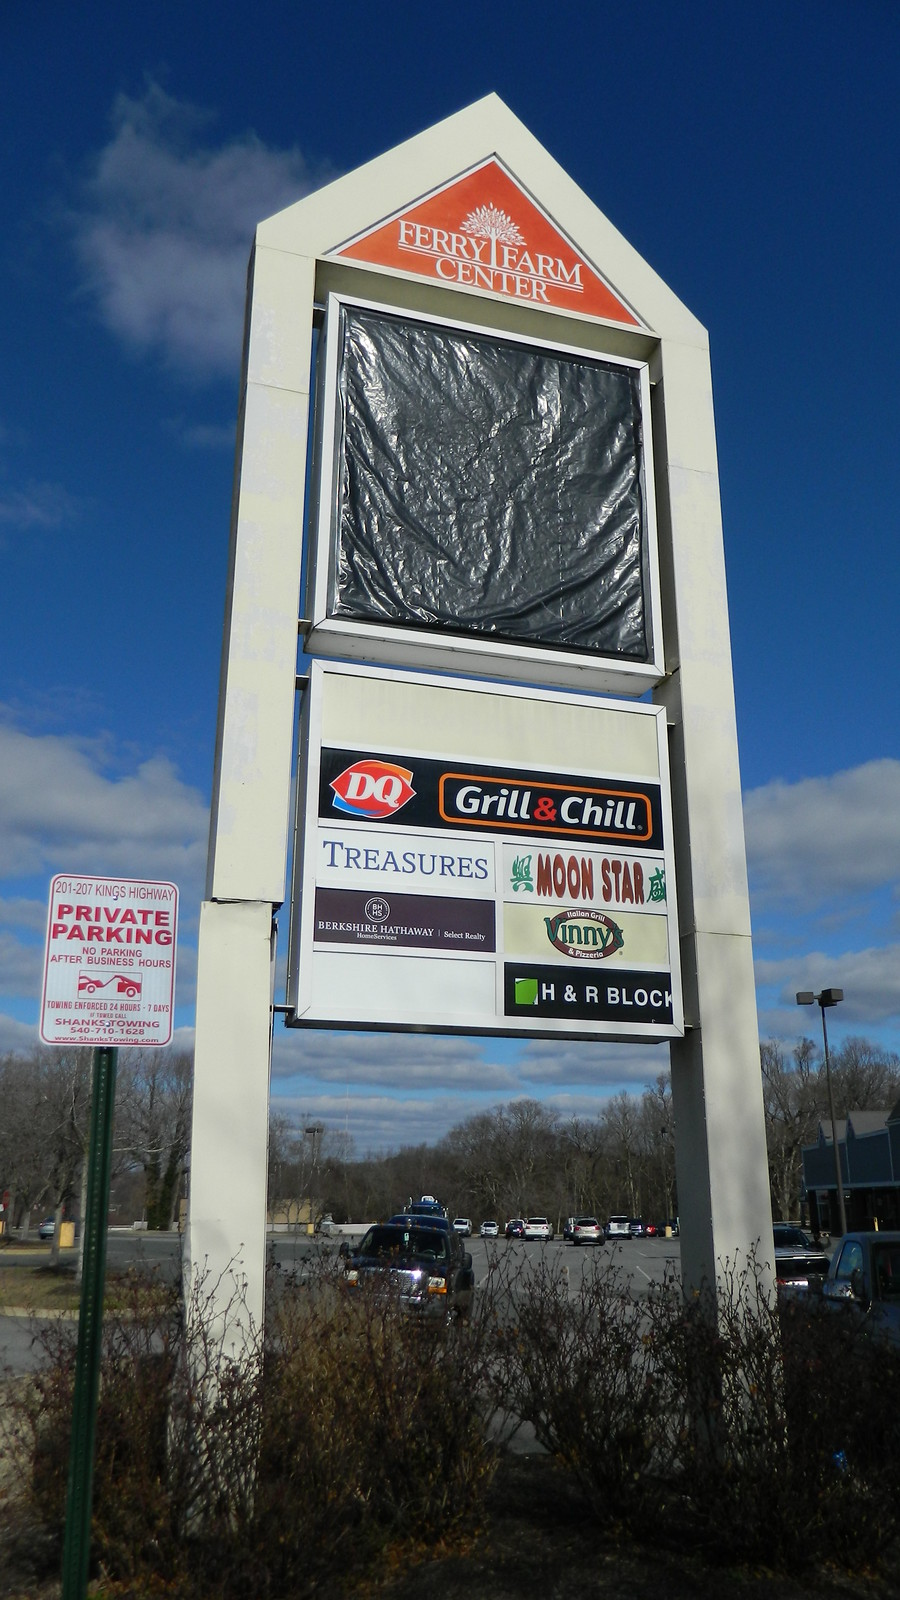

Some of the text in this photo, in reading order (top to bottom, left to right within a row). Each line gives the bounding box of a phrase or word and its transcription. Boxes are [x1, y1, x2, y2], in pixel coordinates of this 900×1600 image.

[398, 219, 583, 286] FERRY FARM
[435, 257, 550, 303] CENTER
[345, 772, 402, 808] DQ
[455, 785, 637, 831] Grill & Chill
[323, 840, 489, 880] TREASURES
[536, 853, 645, 905] MOON STAR
[55, 881, 174, 901] 201-207 KINGS HIGHWAY
[57, 903, 170, 927] PRIVATE
[567, 910, 606, 923] Italian Grill
[52, 923, 173, 946] PARKING
[318, 920, 486, 942] BERKSHIRE HATHAWAY Select Realty
[356, 932, 398, 941] HomeServices
[544, 917, 625, 952] Vinny's
[50, 954, 172, 969] AFTER BUSINESS HOURS
[82, 946, 143, 958] NO PARKING
[568, 947, 604, 959] & Pizzeria
[542, 983, 555, 1001] H
[563, 984, 577, 1002] &
[585, 985, 599, 1003] R
[47, 1000, 73, 1010] TOWING
[74, 1001, 108, 1011] ENFORCED
[109, 1003, 118, 1011] 24
[119, 1003, 141, 1012] HOURS
[147, 1004, 152, 1012] 7
[153, 1004, 170, 1013] DAYS
[55, 1018, 160, 1028] SHANKS TOWING
[70, 1027, 145, 1036] 540-710-1628
[54, 1035, 159, 1044] www.ShanksTowing.com
